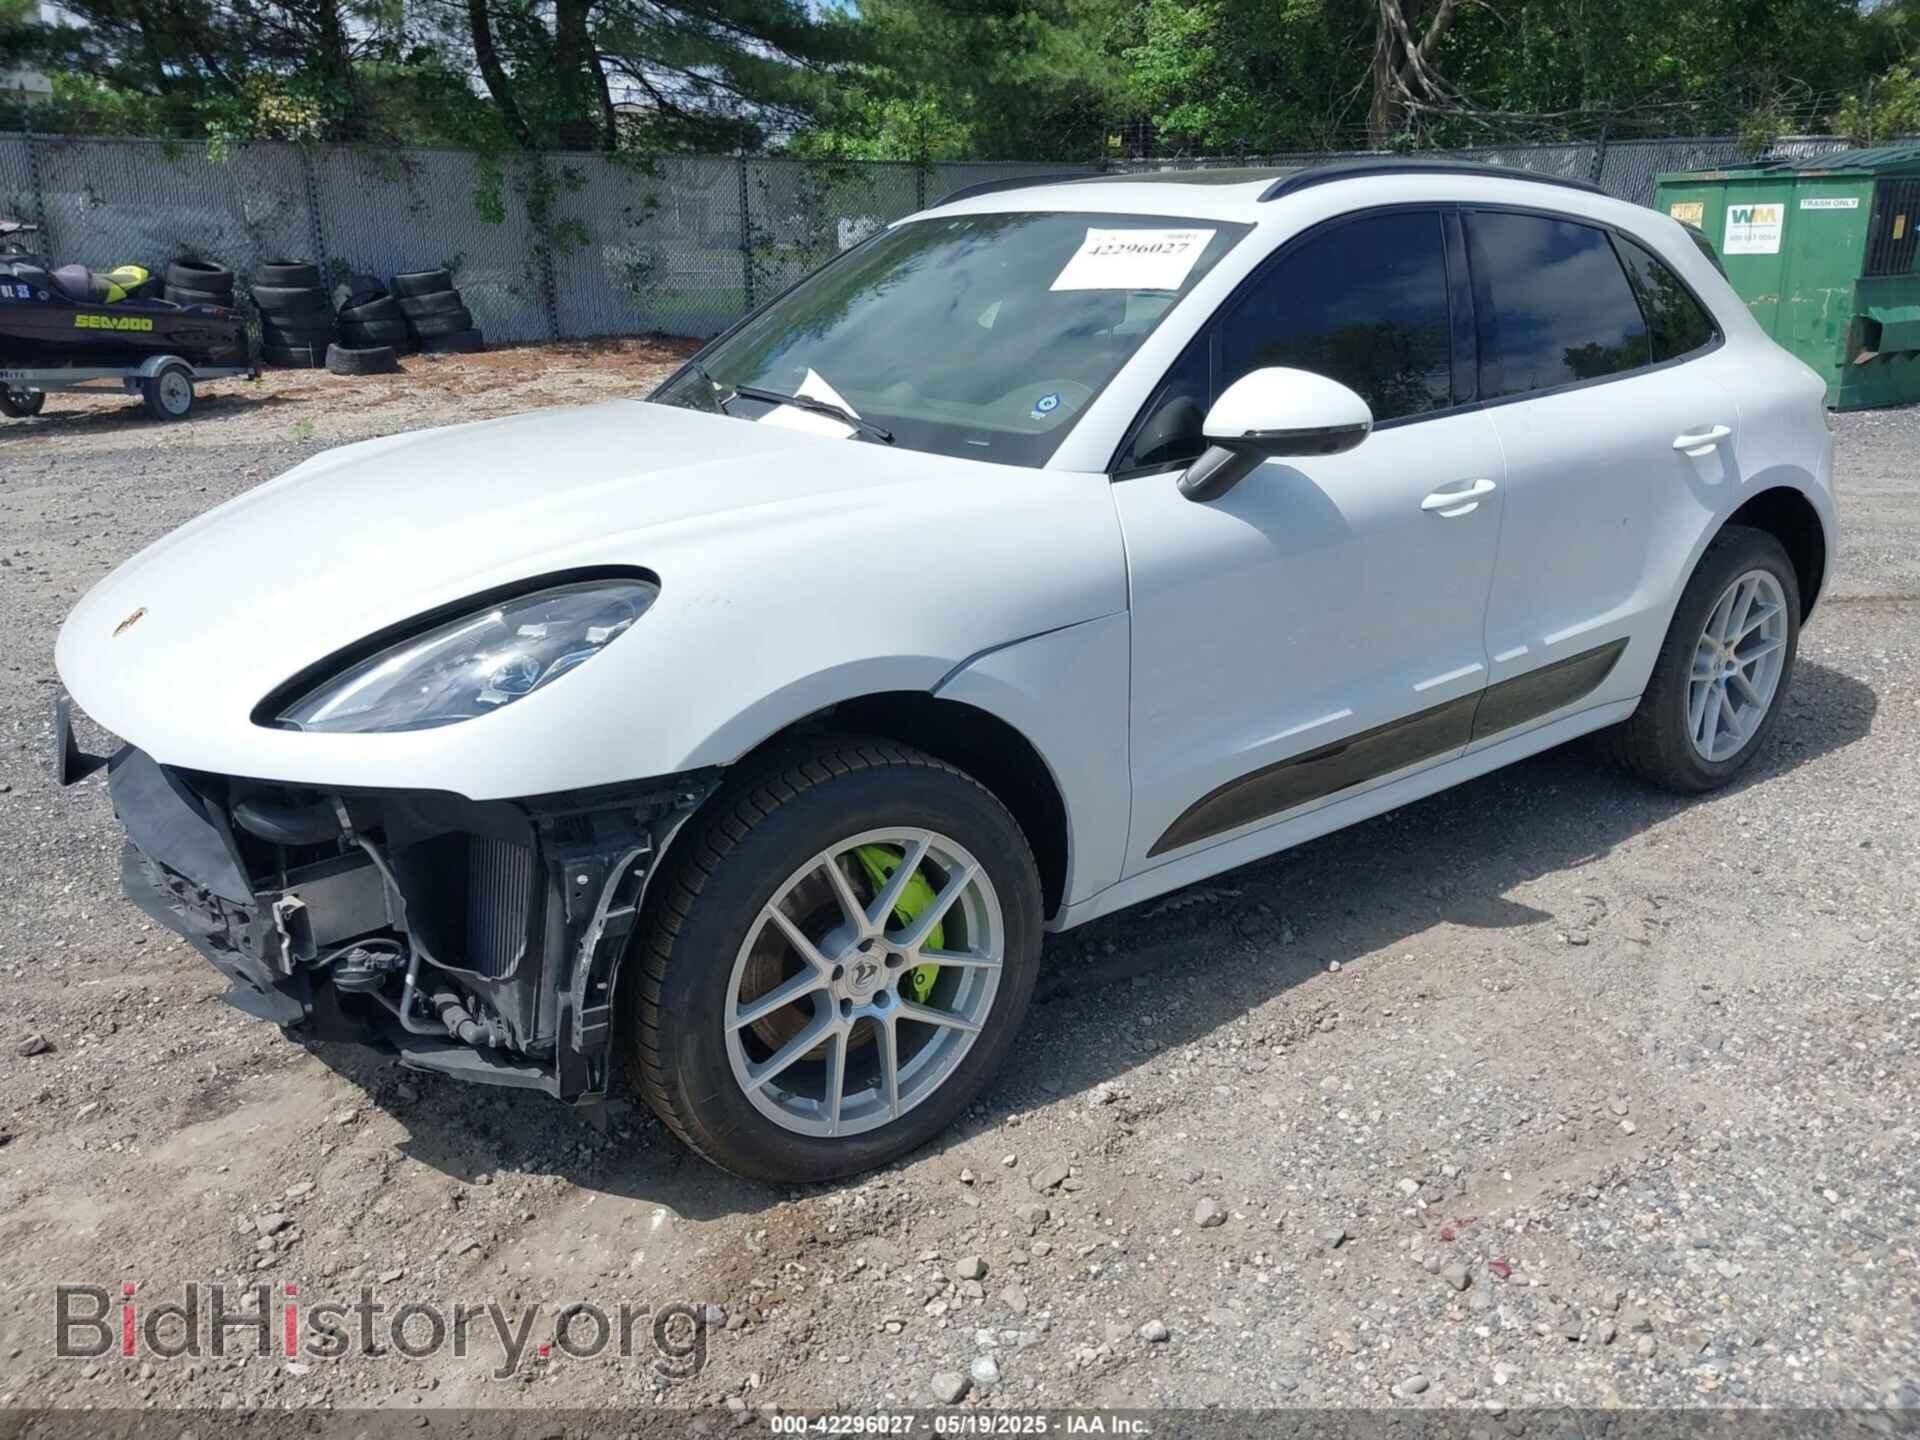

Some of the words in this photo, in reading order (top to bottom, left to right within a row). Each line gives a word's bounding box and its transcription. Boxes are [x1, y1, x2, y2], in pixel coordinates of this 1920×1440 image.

[1803, 198, 1831, 207] TRASH
[1832, 198, 1857, 207] ONLY
[1732, 208, 1777, 224] WM
[1087, 242, 1191, 256] 42296027
